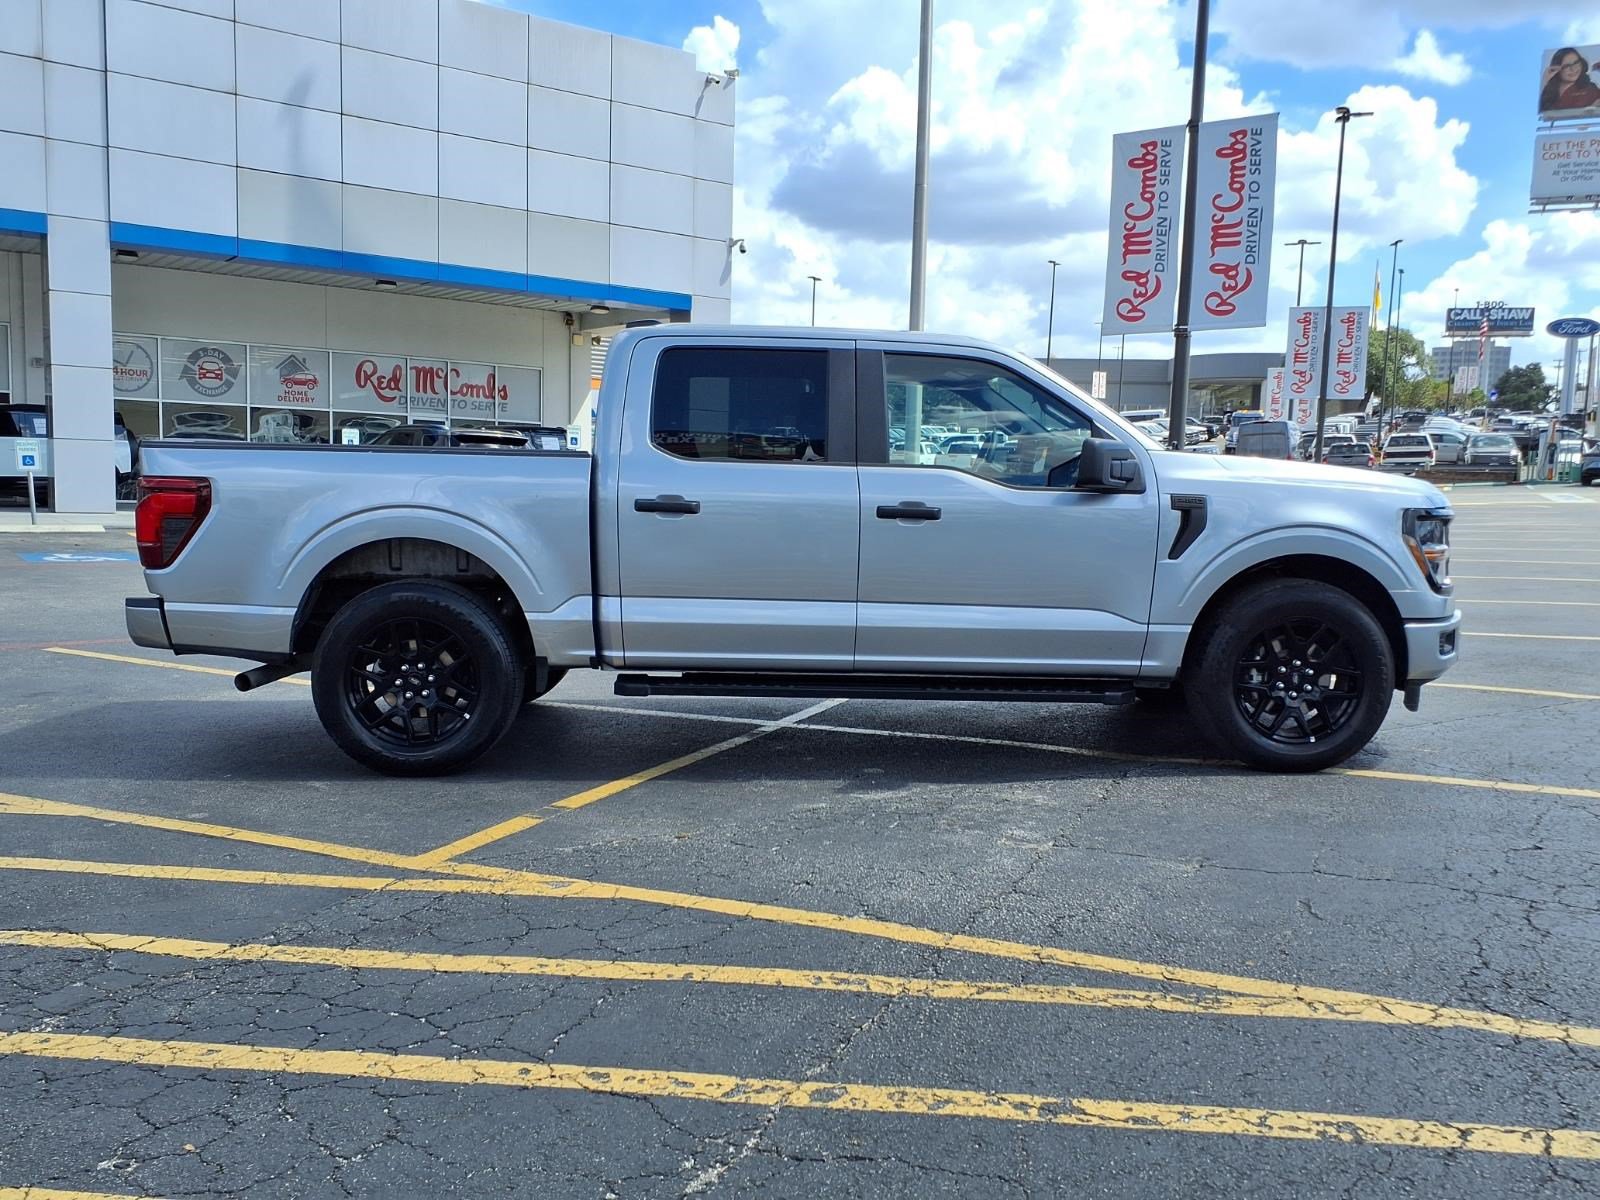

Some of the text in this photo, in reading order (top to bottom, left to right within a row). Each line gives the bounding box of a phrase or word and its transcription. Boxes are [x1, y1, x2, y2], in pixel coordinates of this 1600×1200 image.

[1542, 143, 1561, 152] LET
[1567, 140, 1585, 149] THE
[1542, 151, 1571, 161] COME
[1577, 149, 1590, 158] TO
[1244, 127, 1263, 265] DRIVEN TO SERVE
[1154, 139, 1172, 273] DRIVEN TO SERVE
[1204, 128, 1253, 316] Red McCombs
[1116, 140, 1162, 323] Red McCombs
[1557, 320, 1592, 334] Ford
[1293, 311, 1312, 367] McCombs
[1311, 334, 1318, 345] TO
[1355, 334, 1362, 344] TO
[1308, 347, 1316, 372] DRIVEN
[1334, 311, 1357, 394] Red McCombs
[120, 368, 149, 378] HOUR
[355, 359, 509, 403] Red McCombs
[1290, 369, 1313, 394] Red
[277, 395, 315, 403] DELIVERY
[284, 389, 309, 397] HOME
[398, 395, 509, 412] DRIVEN TO SERVE
[1296, 407, 1312, 425] Red
